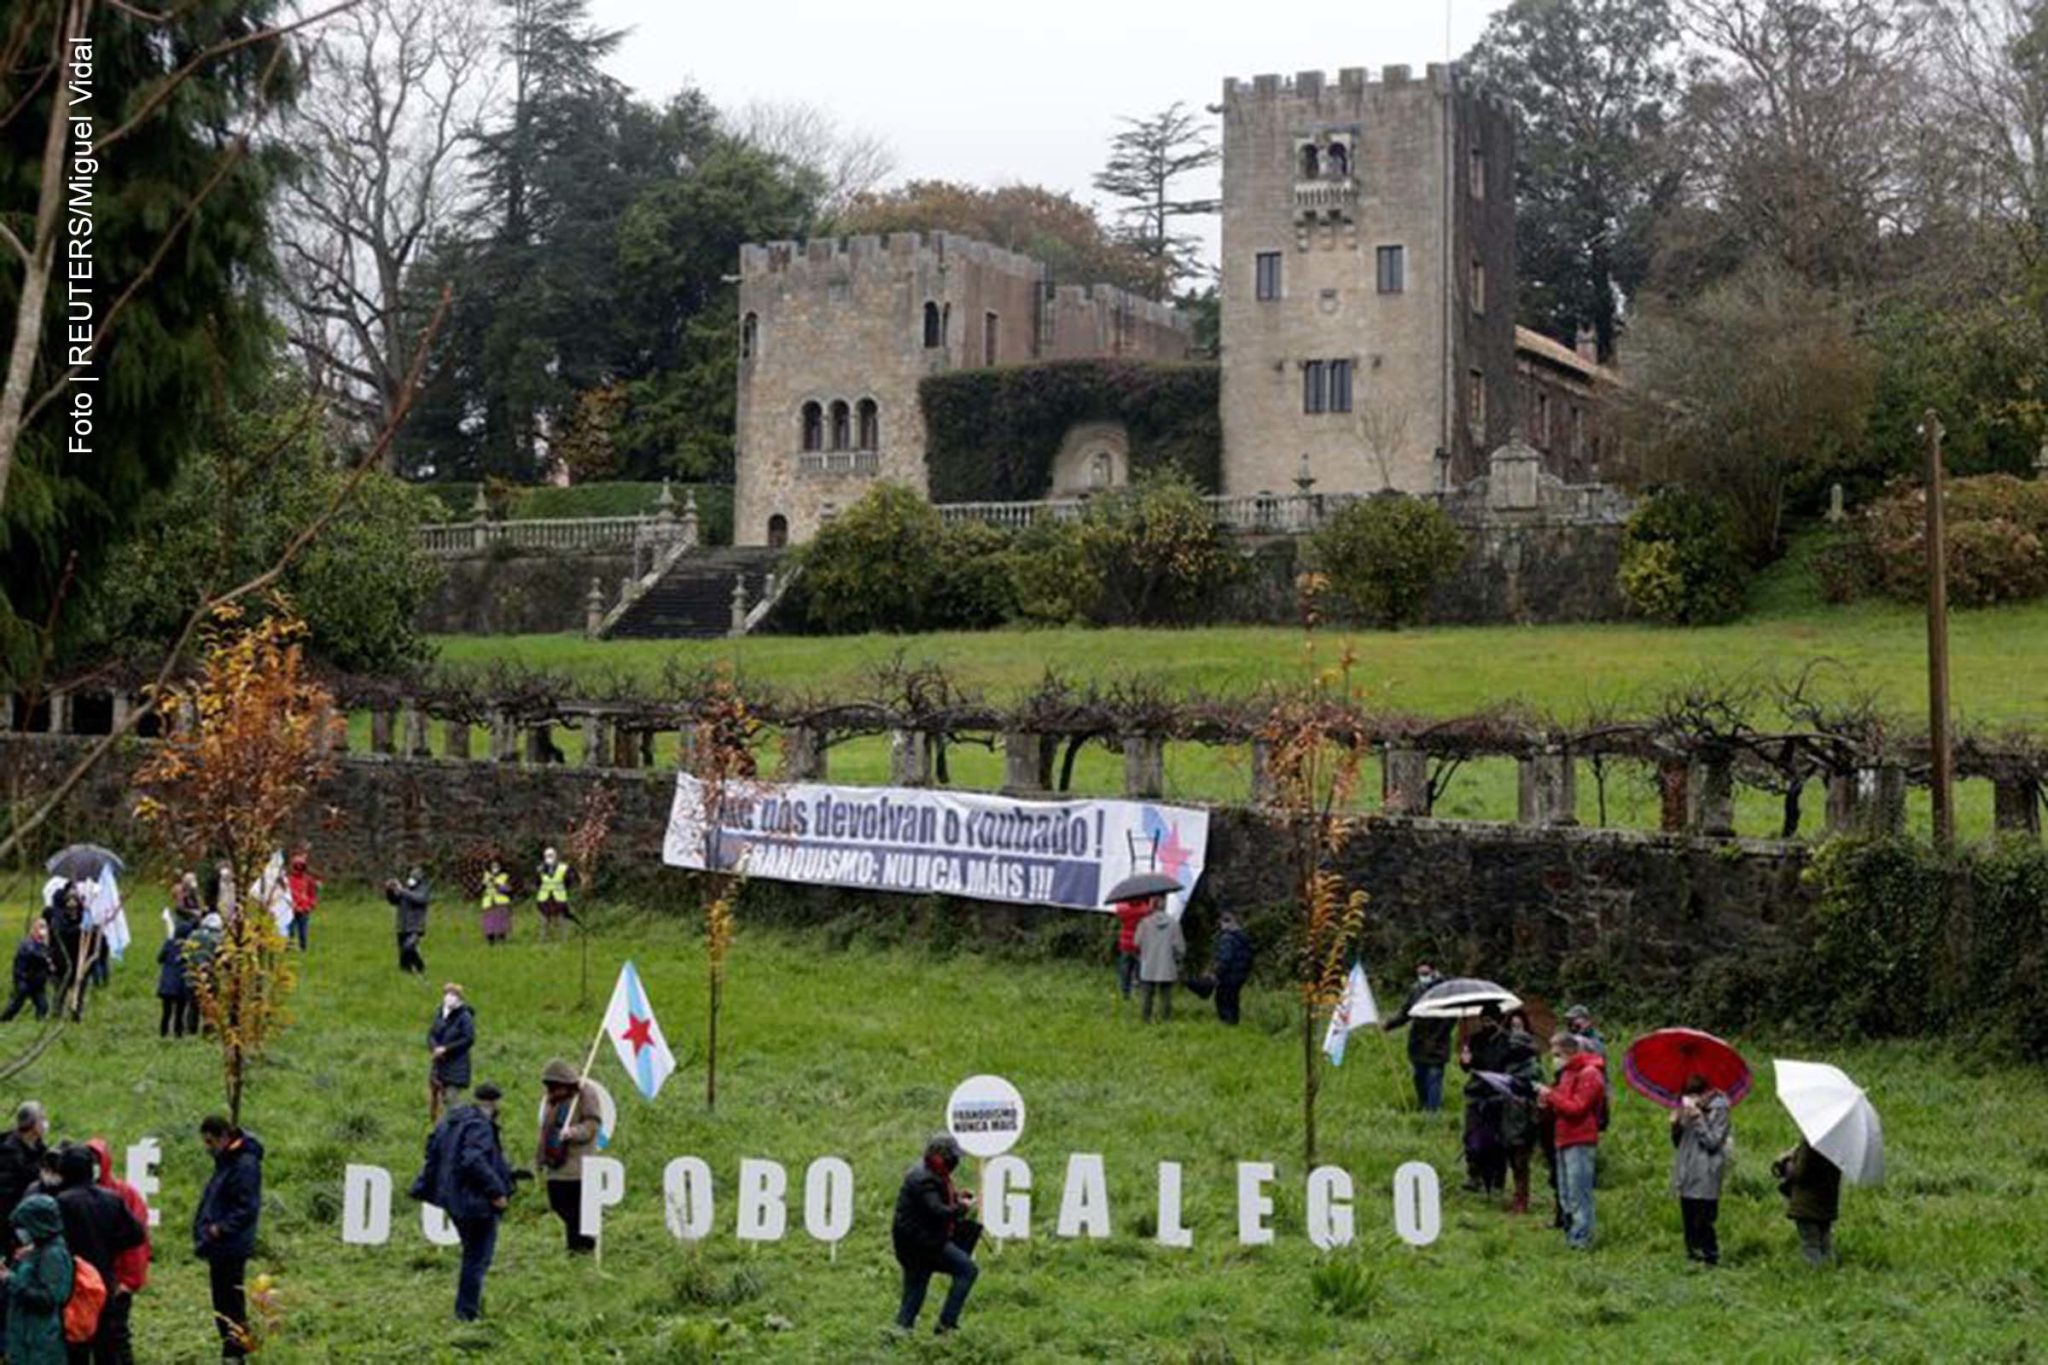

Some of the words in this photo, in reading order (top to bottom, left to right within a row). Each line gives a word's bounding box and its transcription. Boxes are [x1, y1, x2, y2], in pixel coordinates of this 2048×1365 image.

[814, 794, 937, 844] devolvan
[943, 808, 960, 846] o
[966, 805, 1088, 858] roubado
[882, 852, 962, 891] NUNCA
[967, 854, 1024, 898] MÁIS
[1028, 864, 1055, 901] !!!
[579, 1155, 854, 1241] POBO
[981, 1152, 1442, 1251] GALEGO
